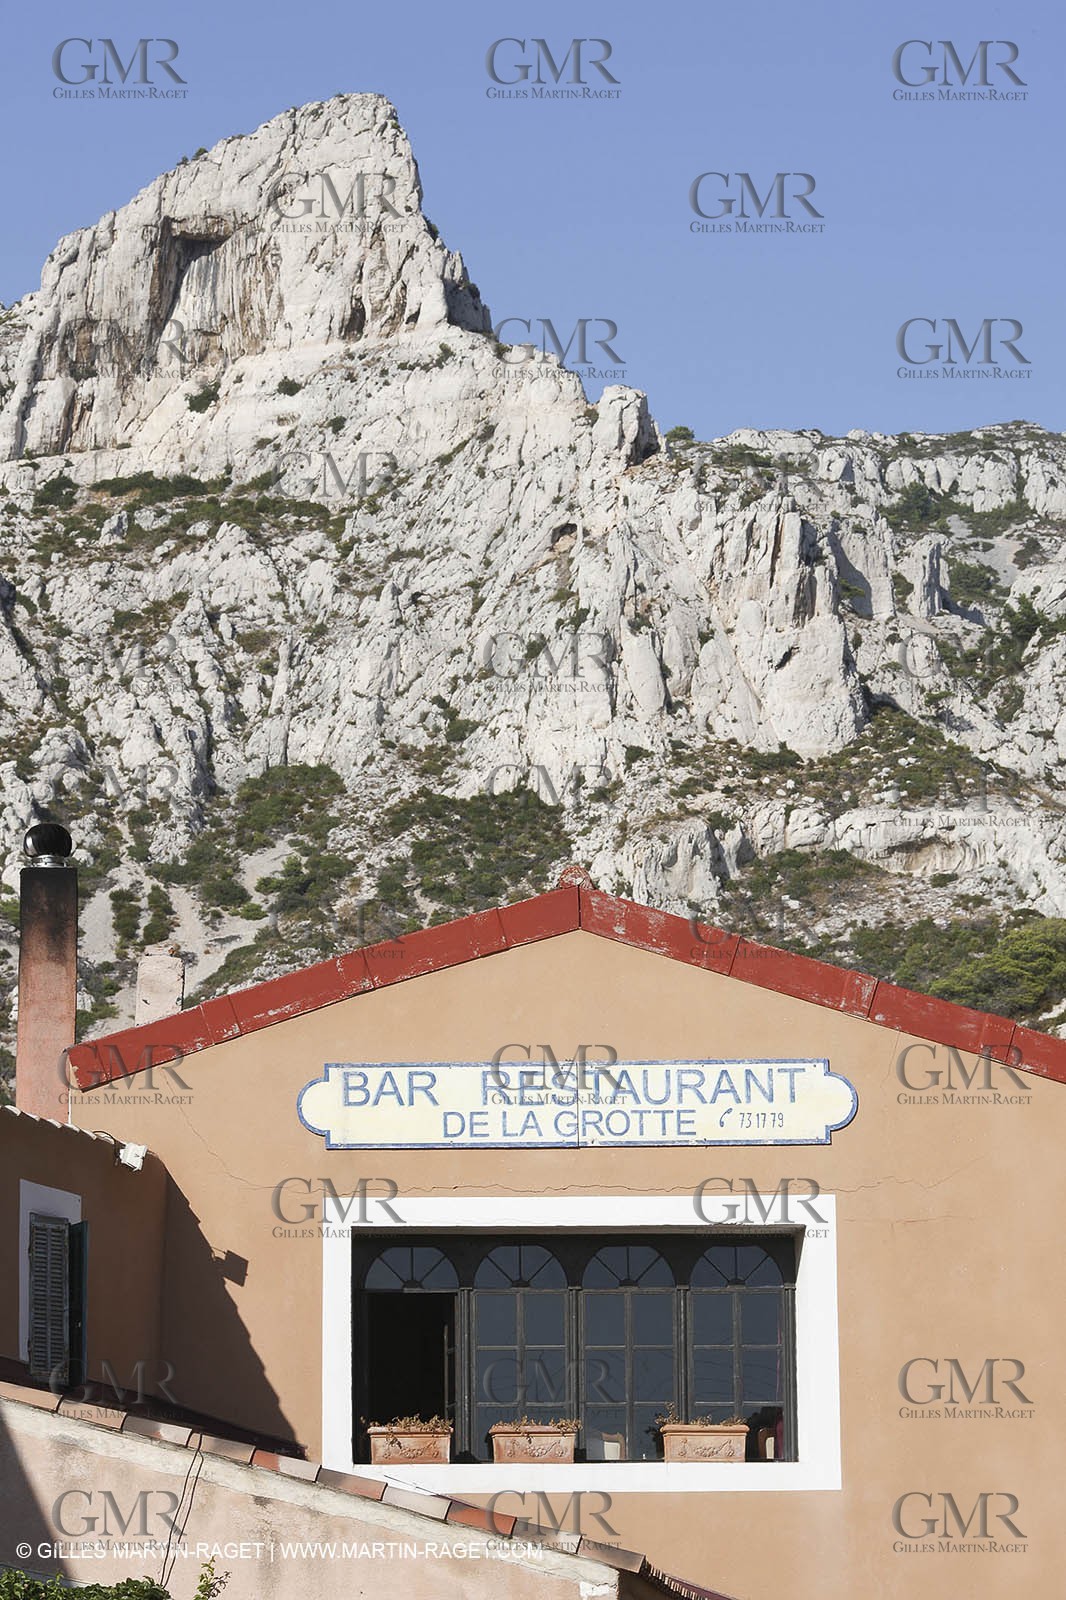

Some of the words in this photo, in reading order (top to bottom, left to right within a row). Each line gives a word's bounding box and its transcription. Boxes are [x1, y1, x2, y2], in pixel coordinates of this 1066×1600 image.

[343, 1071, 439, 1106] BAR
[481, 1067, 806, 1106] RESTAURANT
[443, 1111, 490, 1137] DE
[502, 1110, 543, 1137] LA
[553, 1109, 697, 1137] GROTTE
